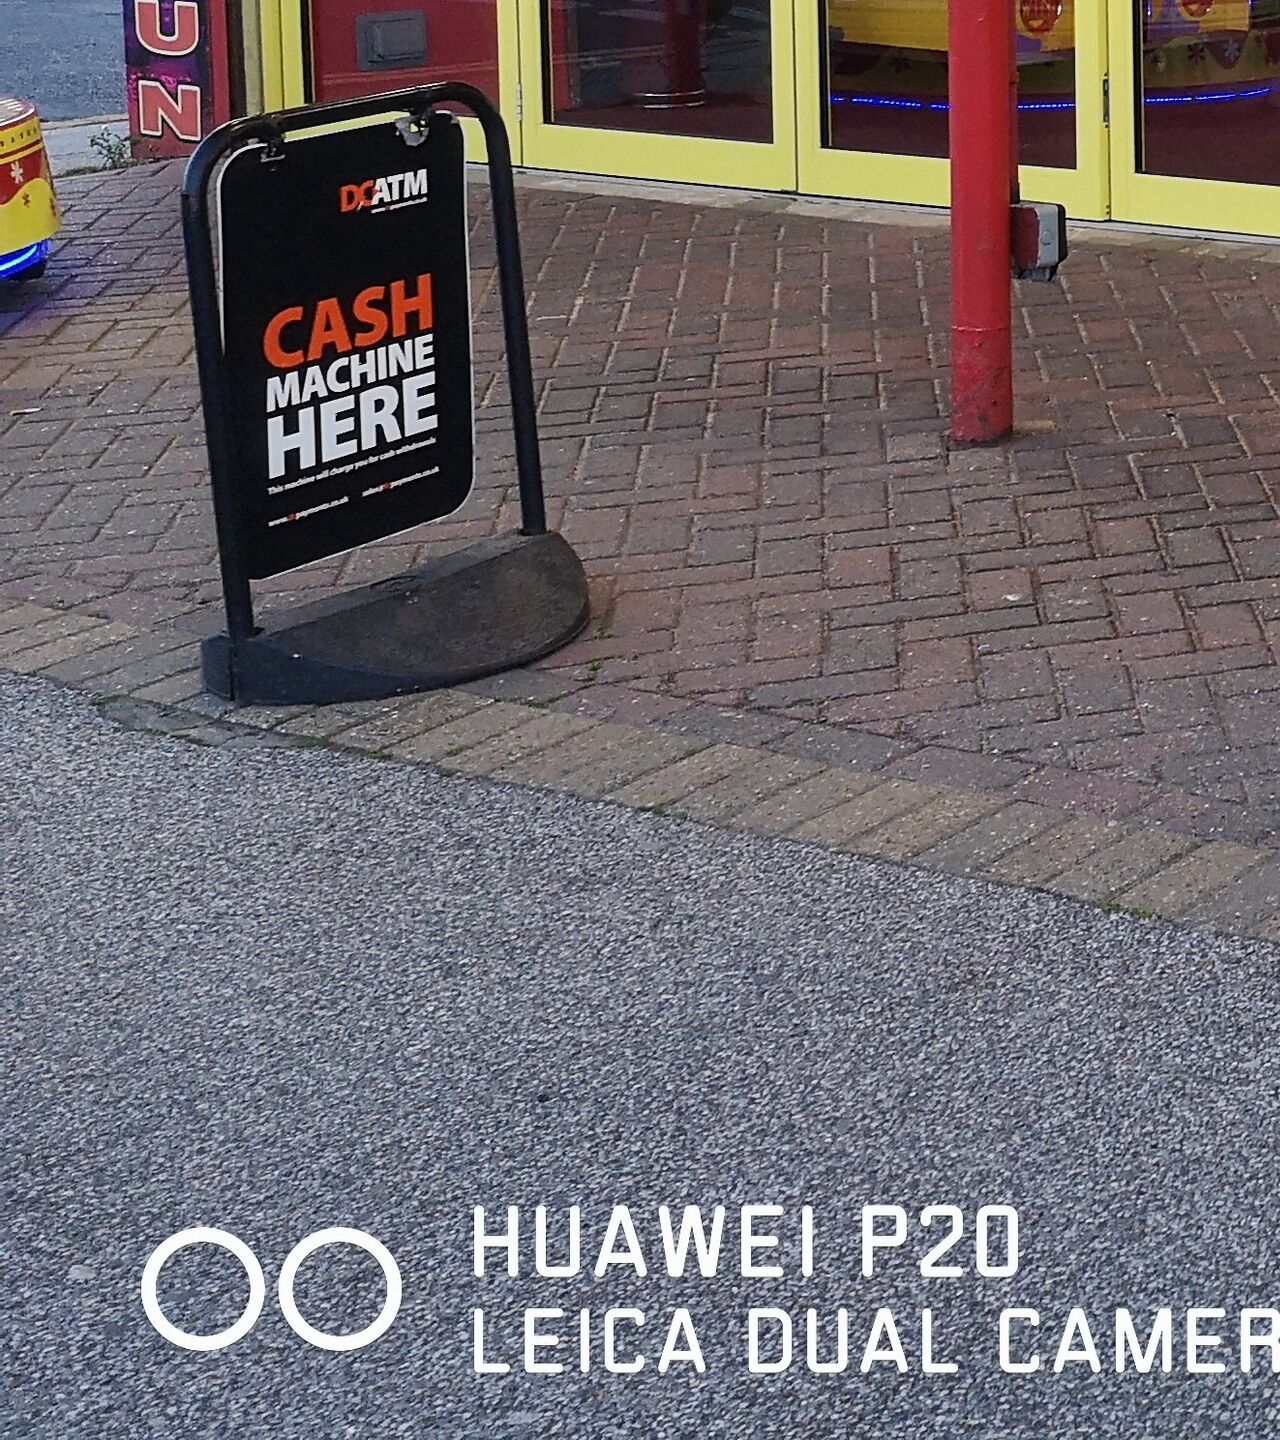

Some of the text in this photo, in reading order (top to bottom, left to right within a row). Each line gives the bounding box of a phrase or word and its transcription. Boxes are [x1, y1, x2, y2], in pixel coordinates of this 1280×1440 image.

[263, 273, 433, 369] CASH
[266, 333, 435, 413] MACHINE
[267, 371, 438, 480] HERE
